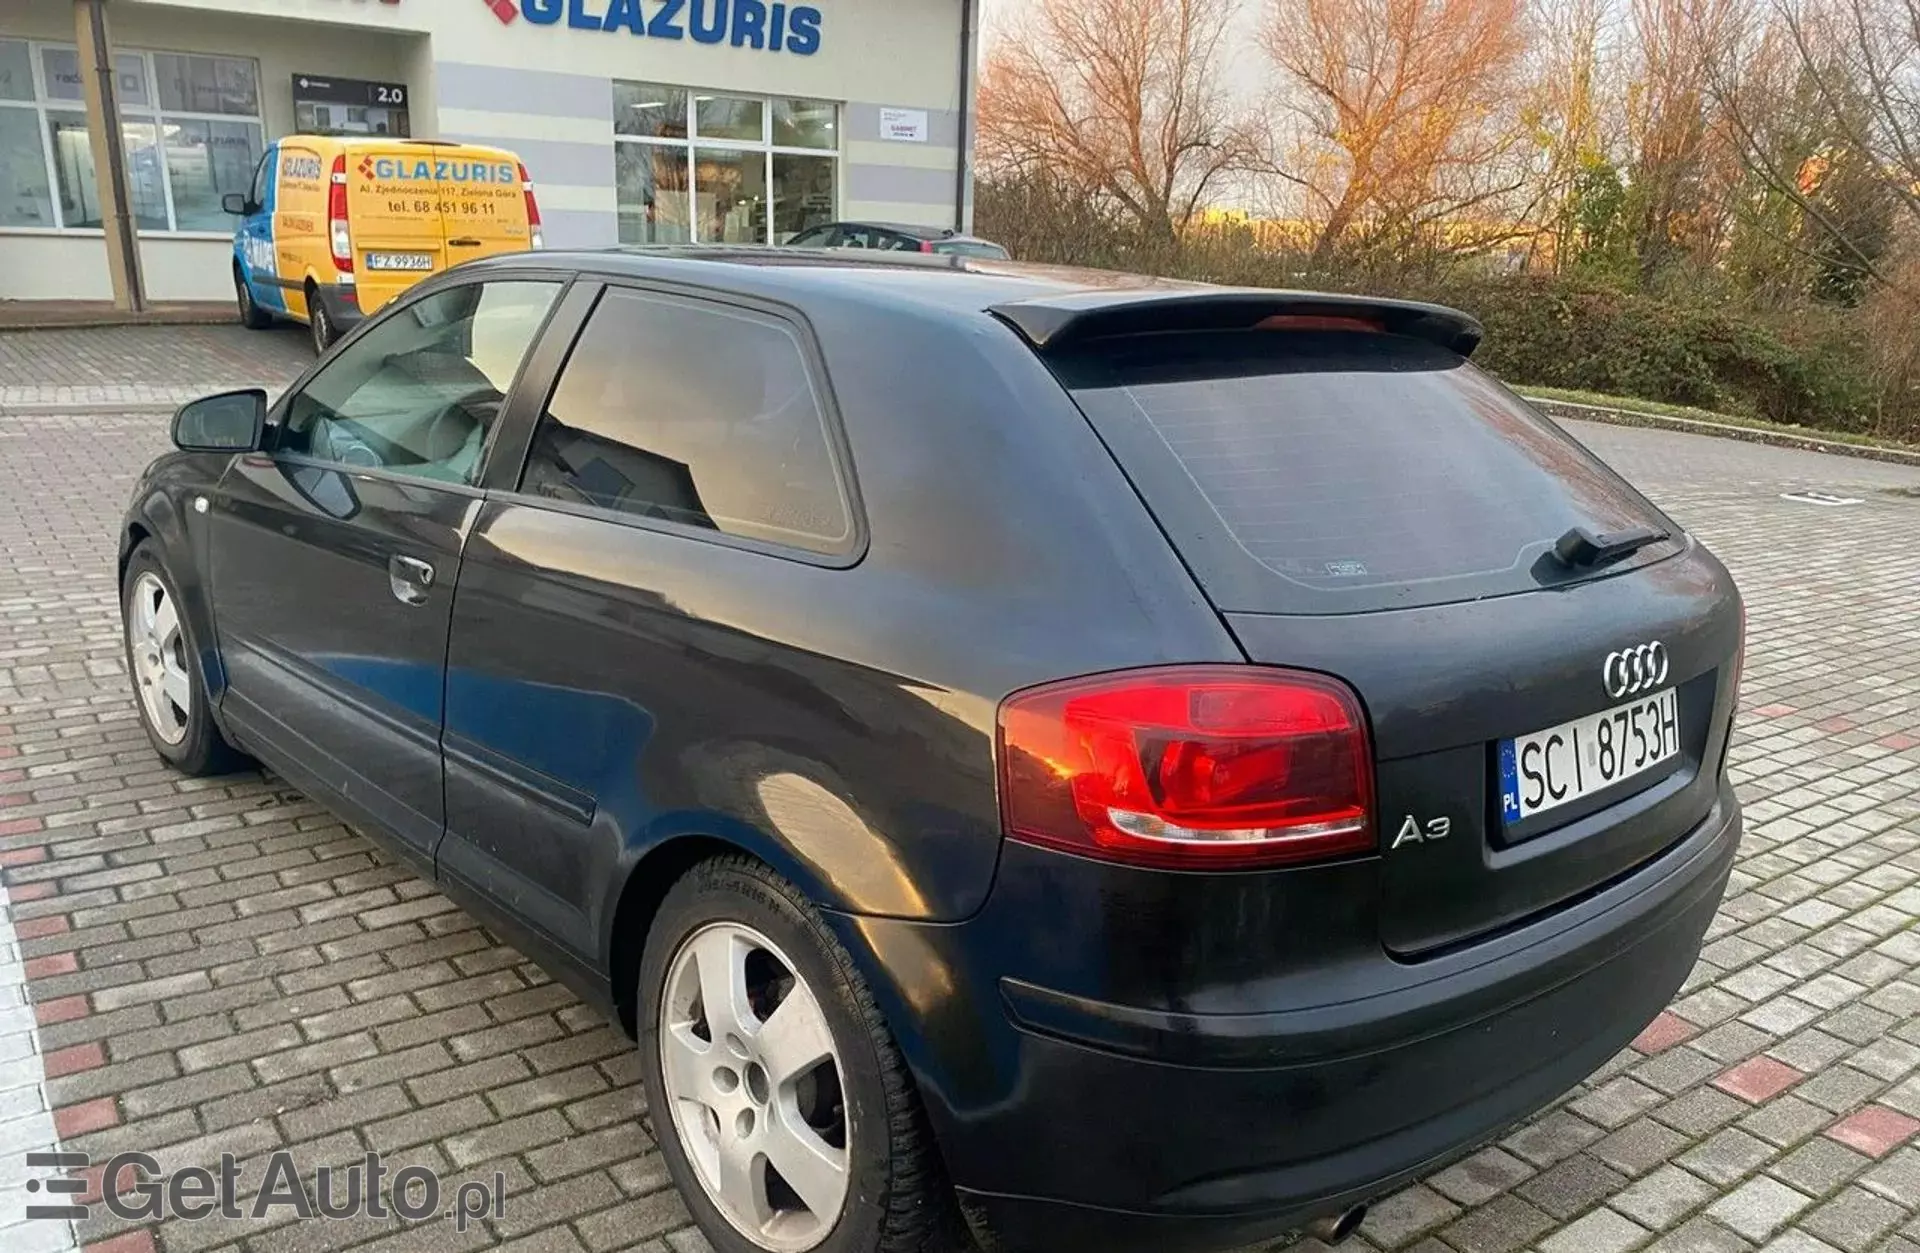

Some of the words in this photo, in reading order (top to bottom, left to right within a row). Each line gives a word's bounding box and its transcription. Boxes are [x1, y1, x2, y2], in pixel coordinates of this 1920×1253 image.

[377, 87, 403, 103] 2.0
[375, 158, 514, 184] GLAZURIS
[388, 200, 411, 213] tel.
[413, 200, 431, 213] 68
[434, 201, 457, 214] 451
[461, 202, 478, 214] 96
[481, 202, 495, 215] 11
[1521, 727, 1583, 808] SCI
[1598, 692, 1679, 781] 8753H
[1503, 792, 1518, 812] PL
[1391, 814, 1450, 849] A3
